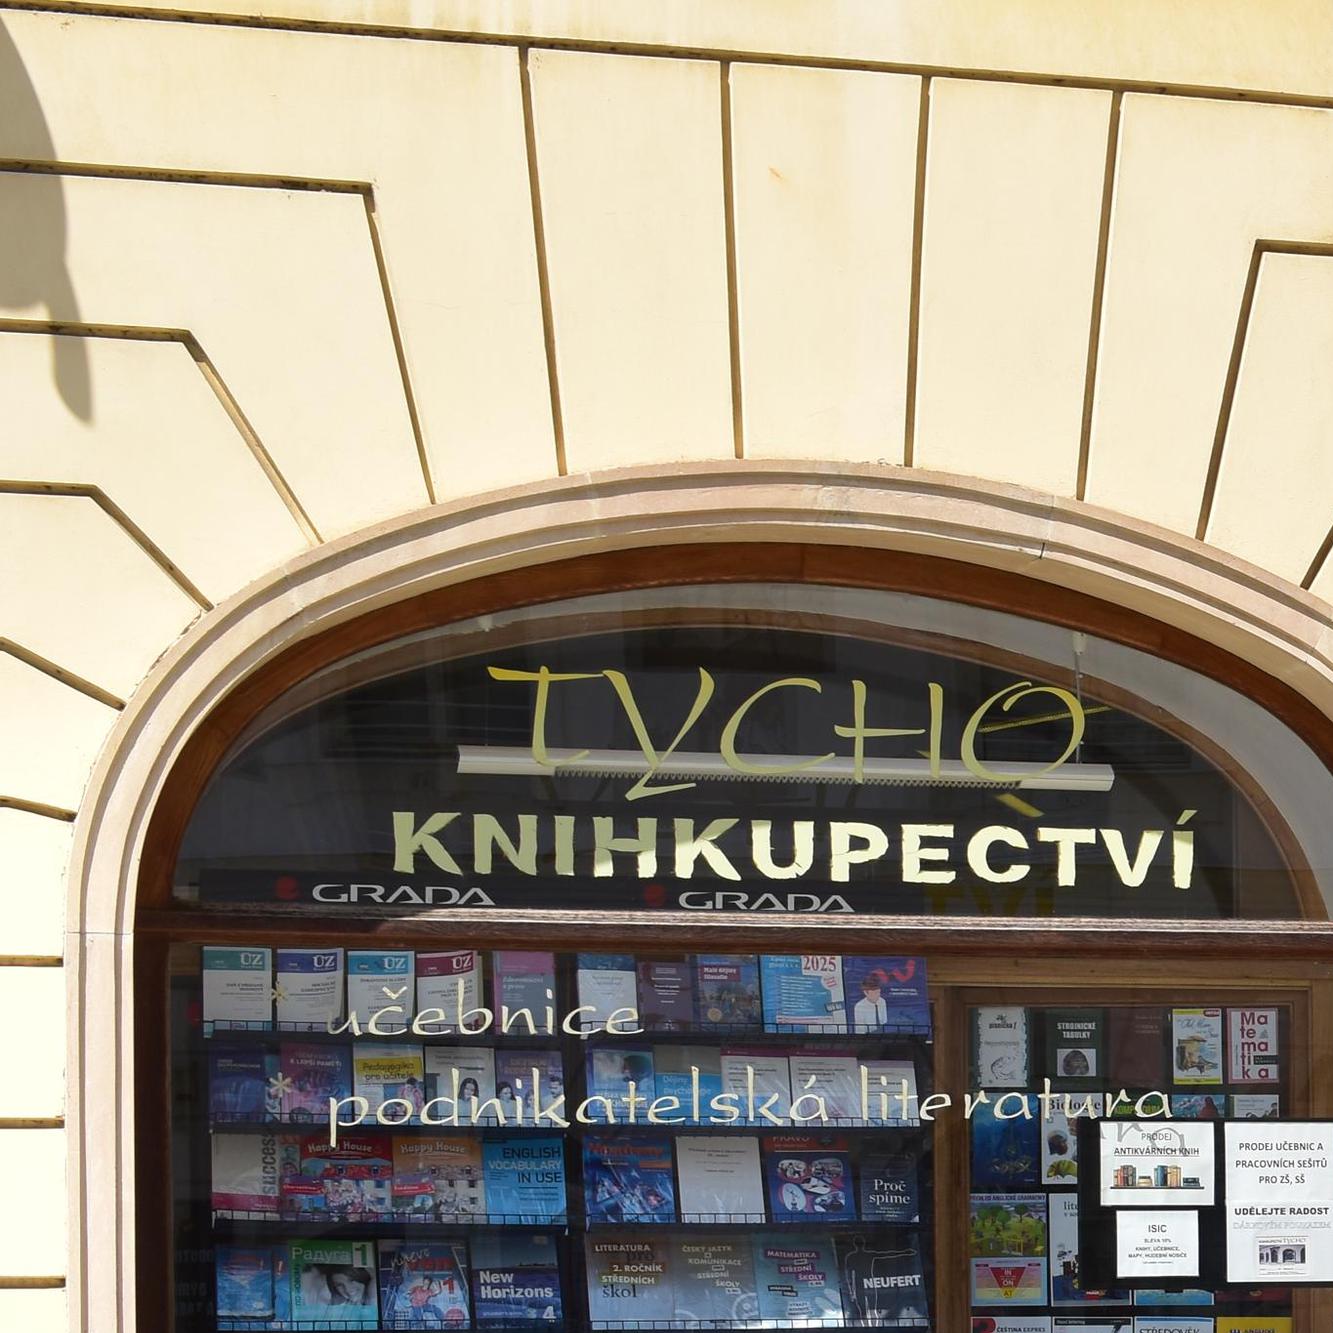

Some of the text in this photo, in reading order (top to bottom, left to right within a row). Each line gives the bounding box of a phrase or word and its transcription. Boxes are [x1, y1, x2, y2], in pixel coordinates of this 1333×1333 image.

[487, 665, 1085, 800] TYCHO
[392, 809, 1197, 889] KNIHKUPECTVÍ
[312, 882, 496, 905] GRADA
[678, 890, 854, 913] GRADA
[803, 957, 837, 972] 2025
[327, 978, 644, 1036] učebnice
[329, 1064, 1173, 1148] podnikatelská literatura
[1141, 1133, 1172, 1141] PRODEJ
[1114, 1146, 1200, 1156] ANTIKVÁRNÍCH KNIH
[1239, 1140, 1324, 1151] PRODEJ UČEBNIC A
[503, 1147, 561, 1159] ENGLISH
[488, 1159, 562, 1171] VOCABULARY
[1235, 1157, 1328, 1169] PRACOVNÍCH SEŠITŮ
[518, 1171, 562, 1184] IN USE
[1258, 1174, 1305, 1187] PRO ZŠ, SŠ
[874, 1178, 906, 1191] Proč
[869, 1191, 911, 1205] spíme
[1235, 1206, 1330, 1216] UDĚLEJTE RADOST
[1148, 1224, 1167, 1233] ISIC
[292, 1247, 350, 1264] Радуга
[624, 1262, 663, 1273] ROČNÍK
[480, 1271, 514, 1284] New
[602, 1273, 656, 1285] STŘEDNÍCH
[863, 1275, 921, 1290] NEUFERT
[480, 1285, 554, 1299] Horizons
[603, 1284, 638, 1298] škol
